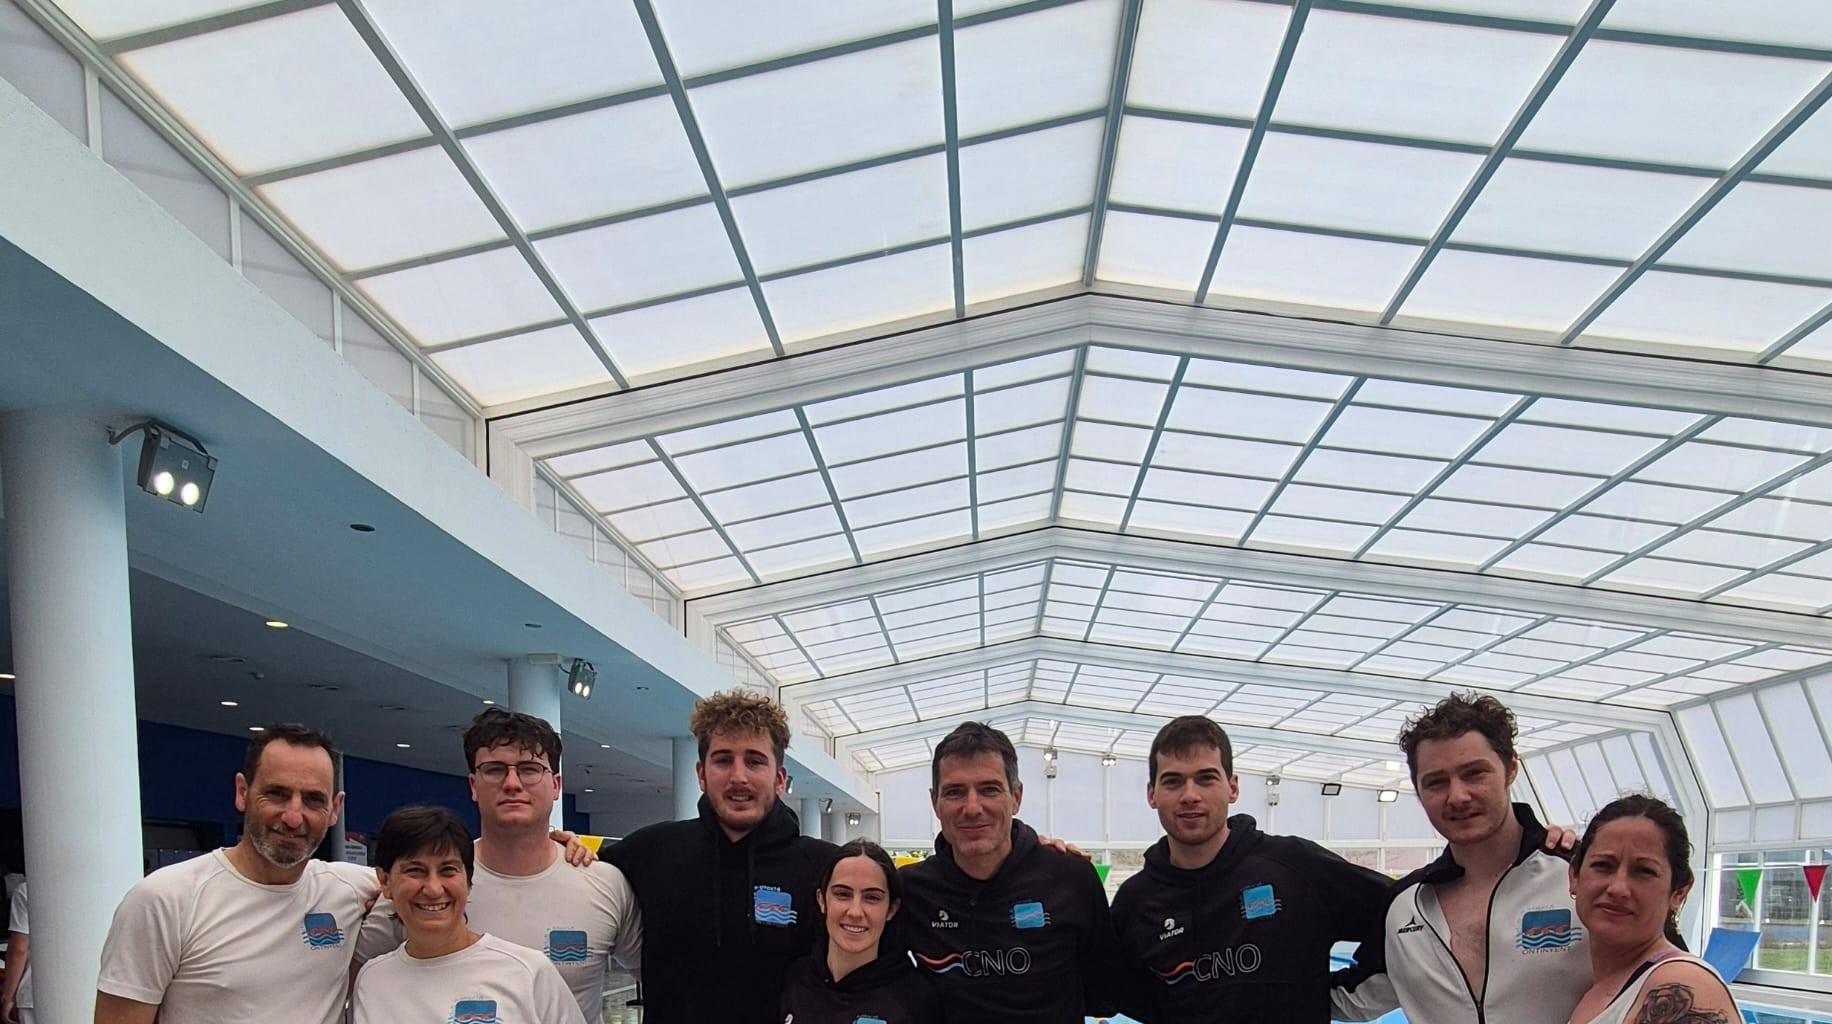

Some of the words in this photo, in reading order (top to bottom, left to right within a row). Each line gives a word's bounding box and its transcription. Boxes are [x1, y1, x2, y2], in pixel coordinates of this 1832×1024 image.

[931, 921, 959, 929] VIATOR
[1160, 926, 1185, 940] VIATOR
[961, 946, 1031, 977] CNO
[1193, 943, 1262, 982] CNO
